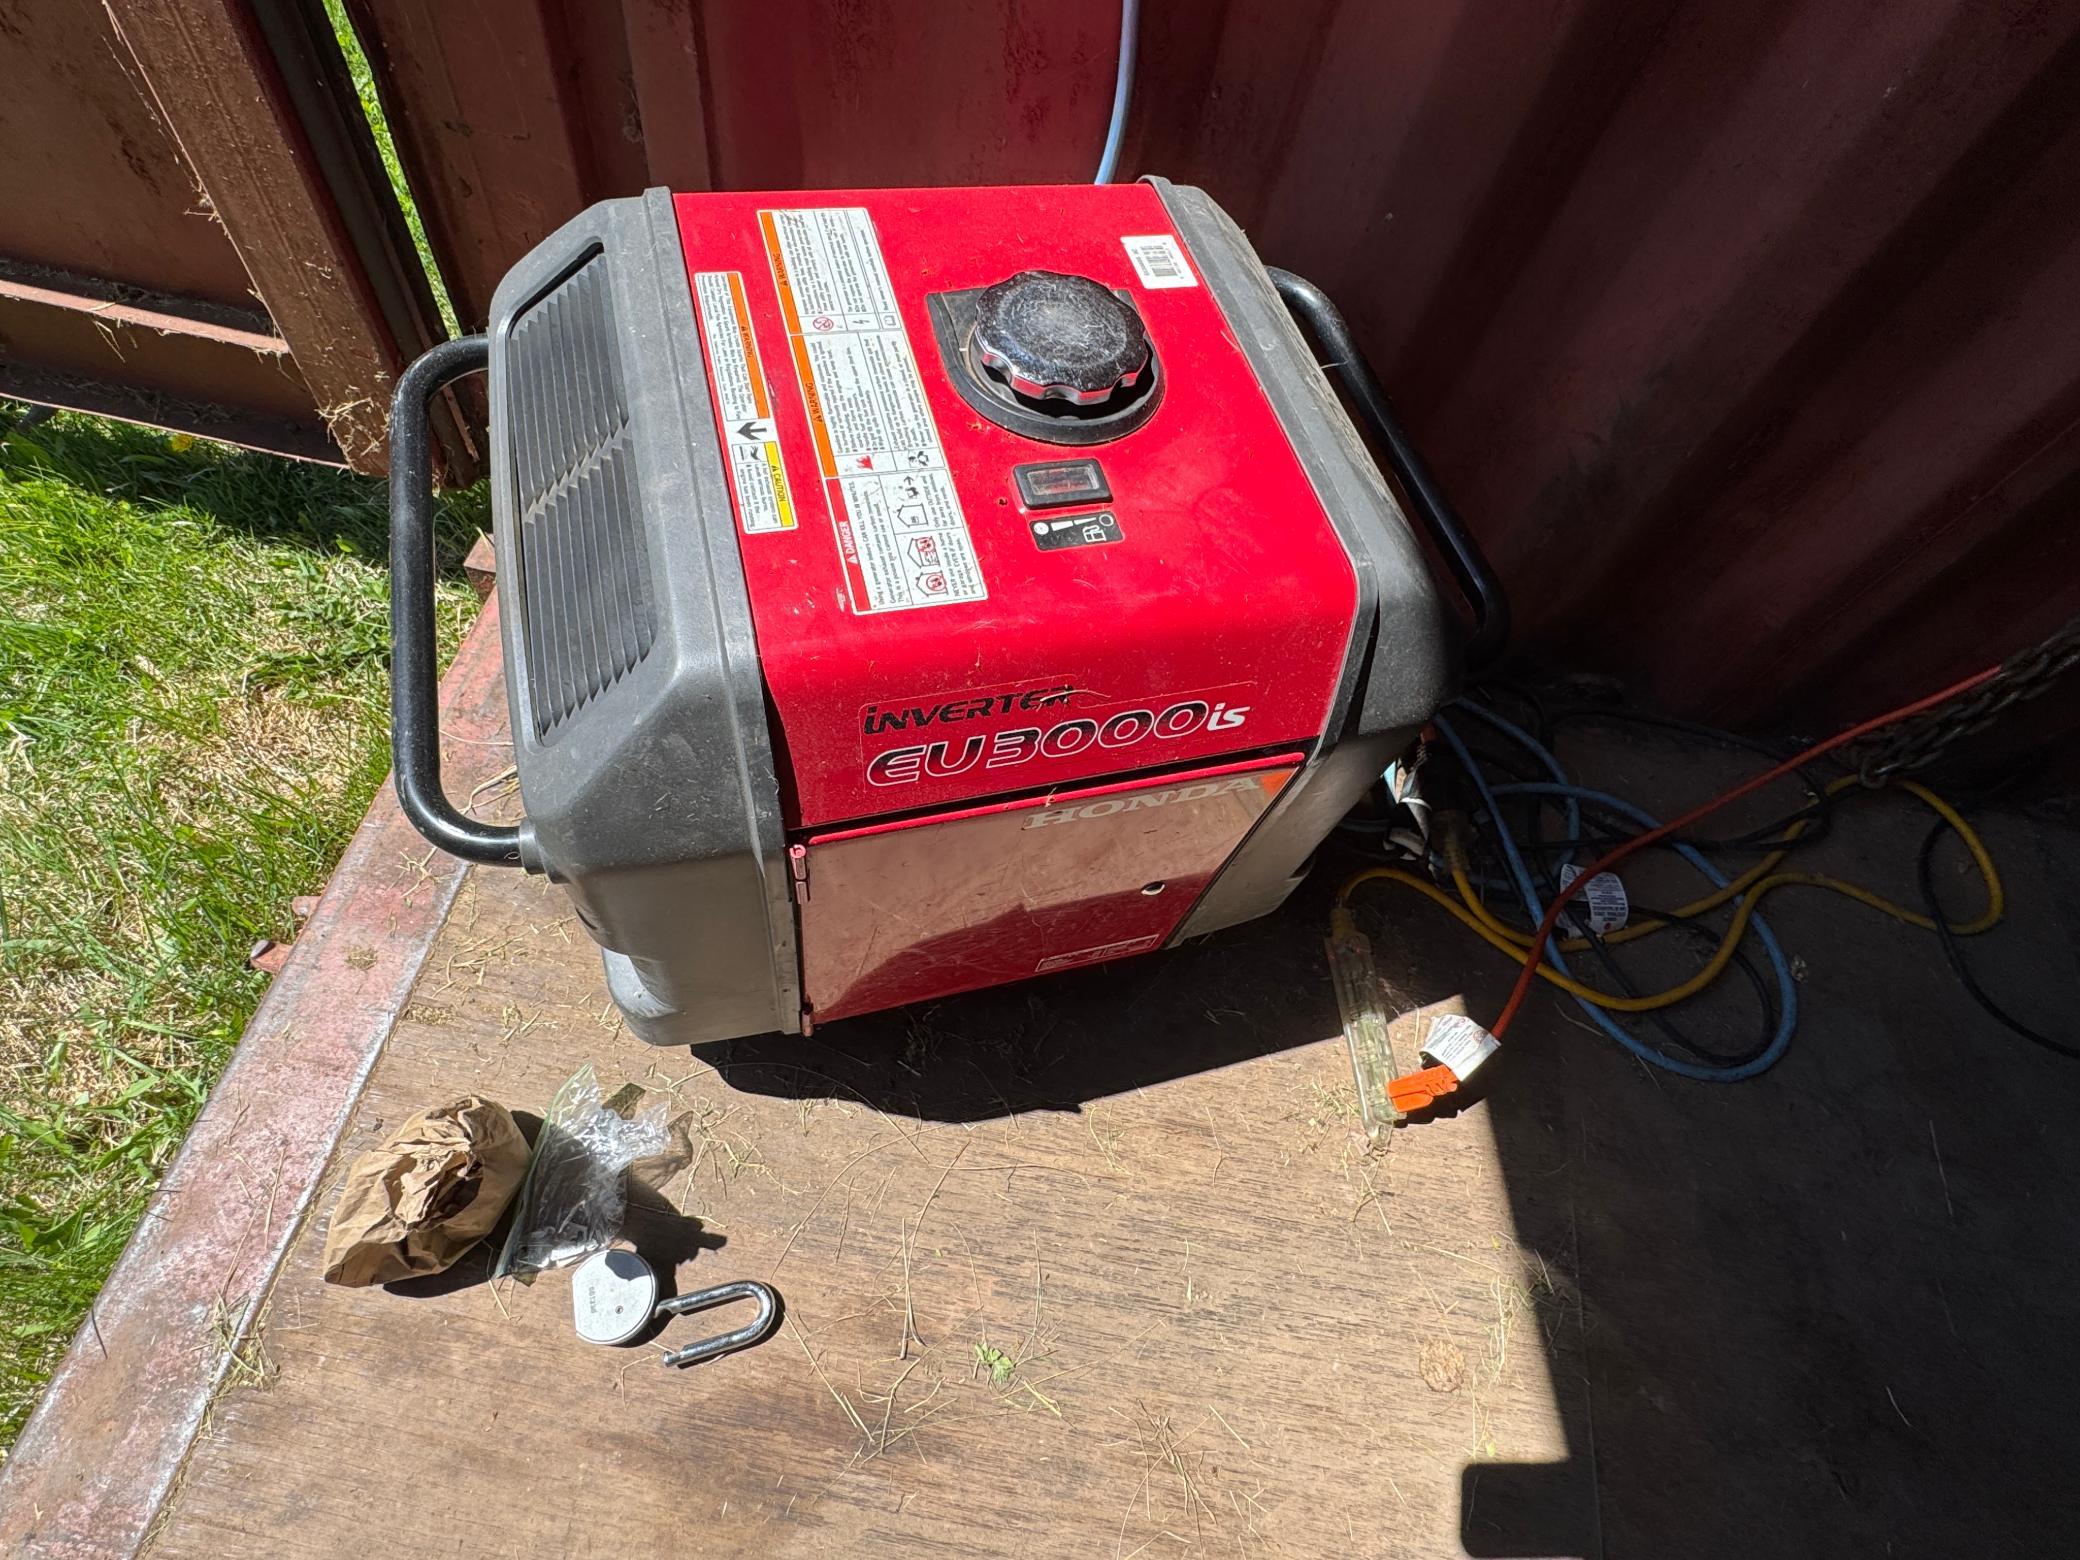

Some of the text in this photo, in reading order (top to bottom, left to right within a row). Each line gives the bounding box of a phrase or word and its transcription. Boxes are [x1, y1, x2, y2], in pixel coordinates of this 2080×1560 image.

[804, 382, 820, 413] WARNING
[773, 473, 786, 501] CAUTION
[838, 520, 855, 554] DANGER
[867, 700, 1250, 787] EU3000is
[1024, 778, 1259, 830] HONDA
